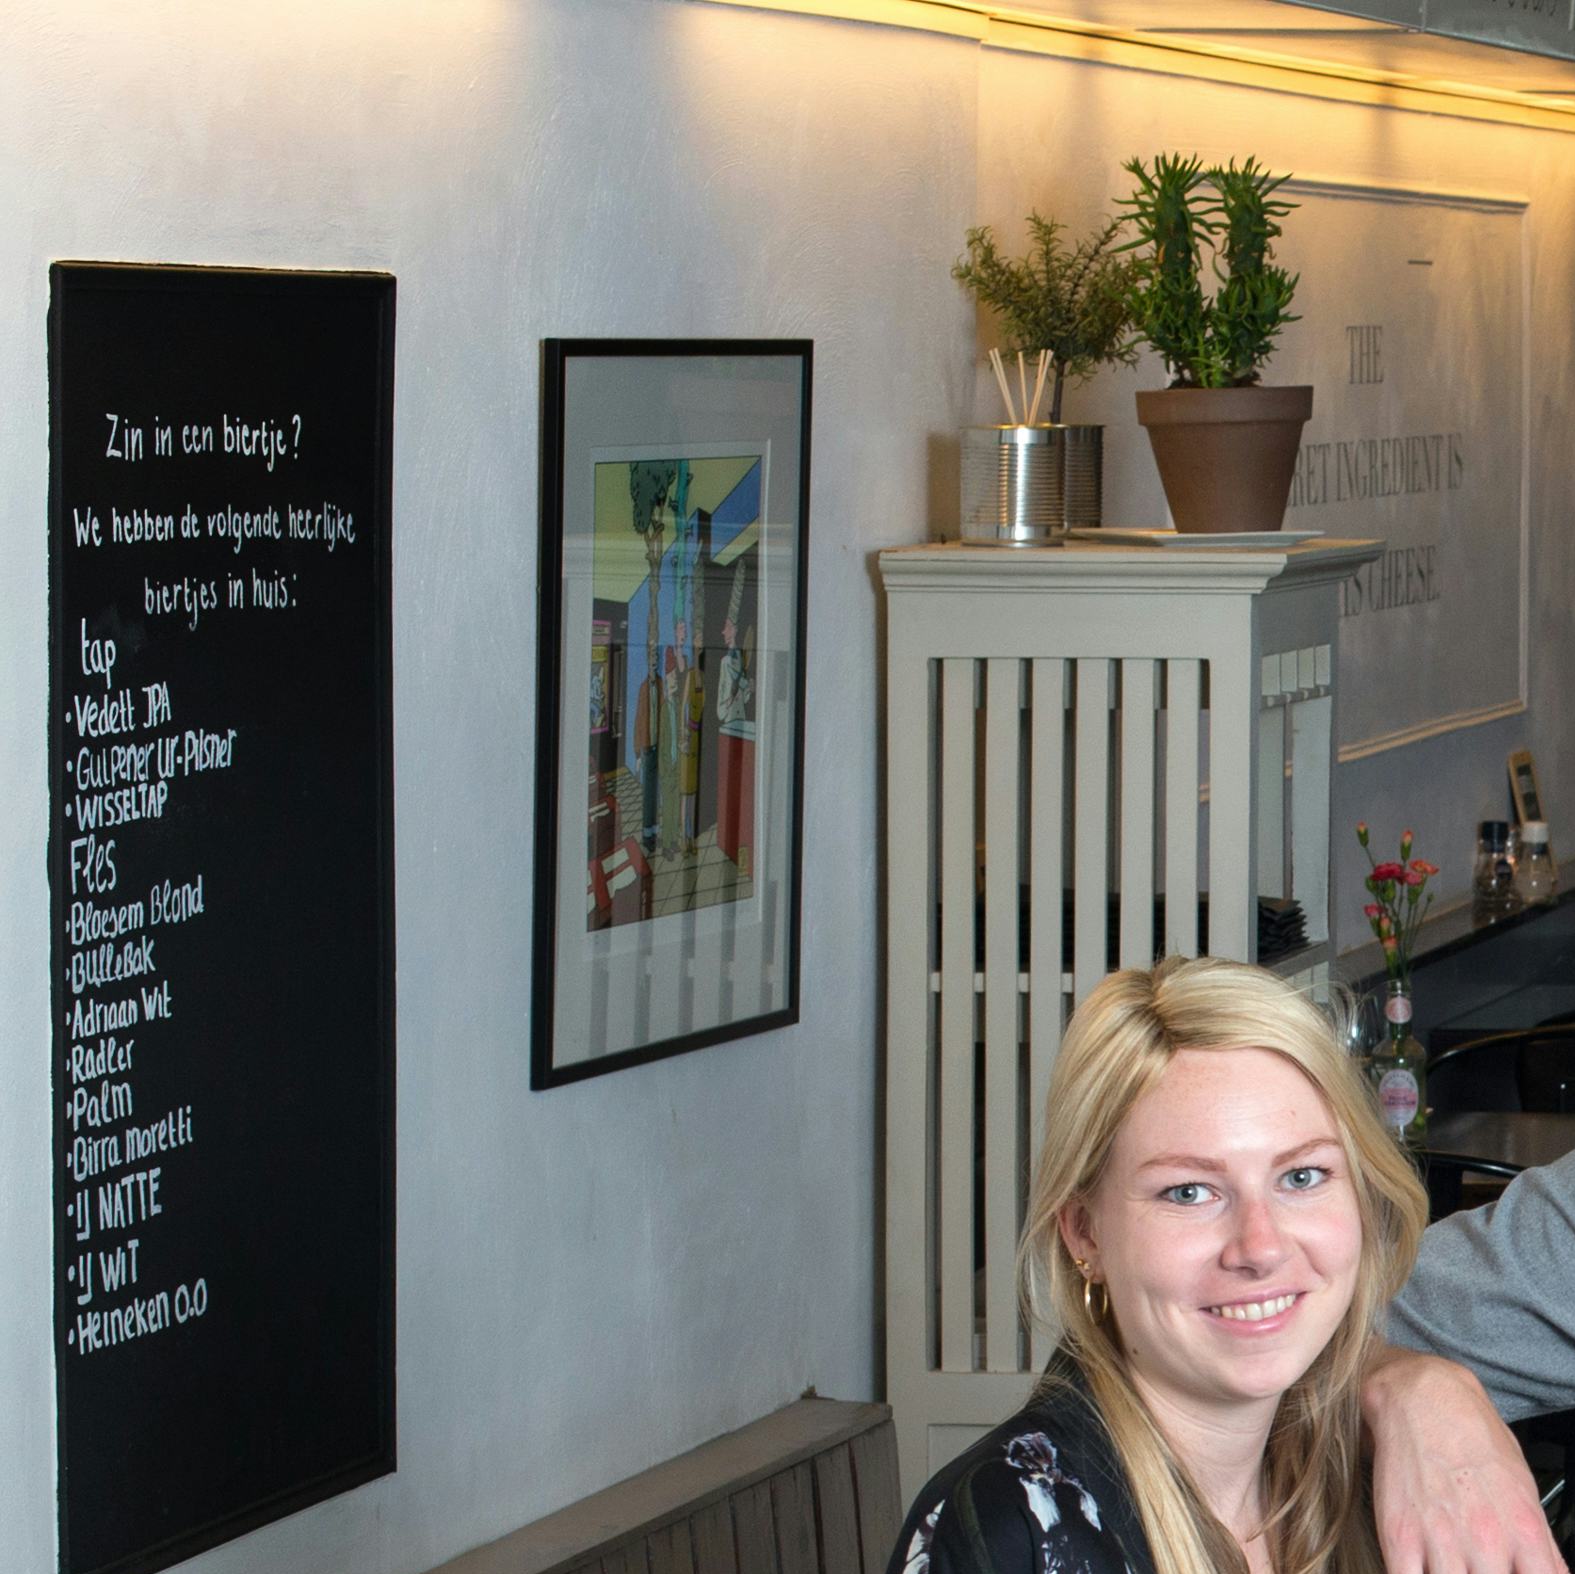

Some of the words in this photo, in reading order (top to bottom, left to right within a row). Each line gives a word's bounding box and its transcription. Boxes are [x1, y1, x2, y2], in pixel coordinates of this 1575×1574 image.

[1346, 325, 1384, 385] THE
[105, 413, 143, 462] Zin
[155, 415, 172, 456] in
[182, 424, 213, 453] een
[1335, 434, 1444, 502] INGREDIENT
[1447, 432, 1465, 490] IS
[73, 506, 103, 548] We
[112, 506, 174, 544] hebben
[181, 503, 201, 539] de
[207, 503, 282, 555] volgende
[288, 501, 357, 553] heerlijke
[144, 576, 218, 632] biertjes
[227, 572, 244, 609] in
[81, 616, 117, 689] tap
[73, 687, 136, 738] Vedett
[76, 741, 155, 791] Gulpener
[75, 780, 169, 832] WISSELTAP
[71, 833, 117, 895] Fles
[71, 901, 144, 946] Bloesem
[150, 874, 205, 925] Blond
[71, 999, 139, 1040] Adriaan
[141, 980, 172, 1022] Wit
[71, 1036, 135, 1084] Radler
[73, 1079, 133, 1132] Palm
[73, 1135, 122, 1182] Birra
[98, 1167, 163, 1231] NATTE
[77, 1291, 171, 1356] Heineken
